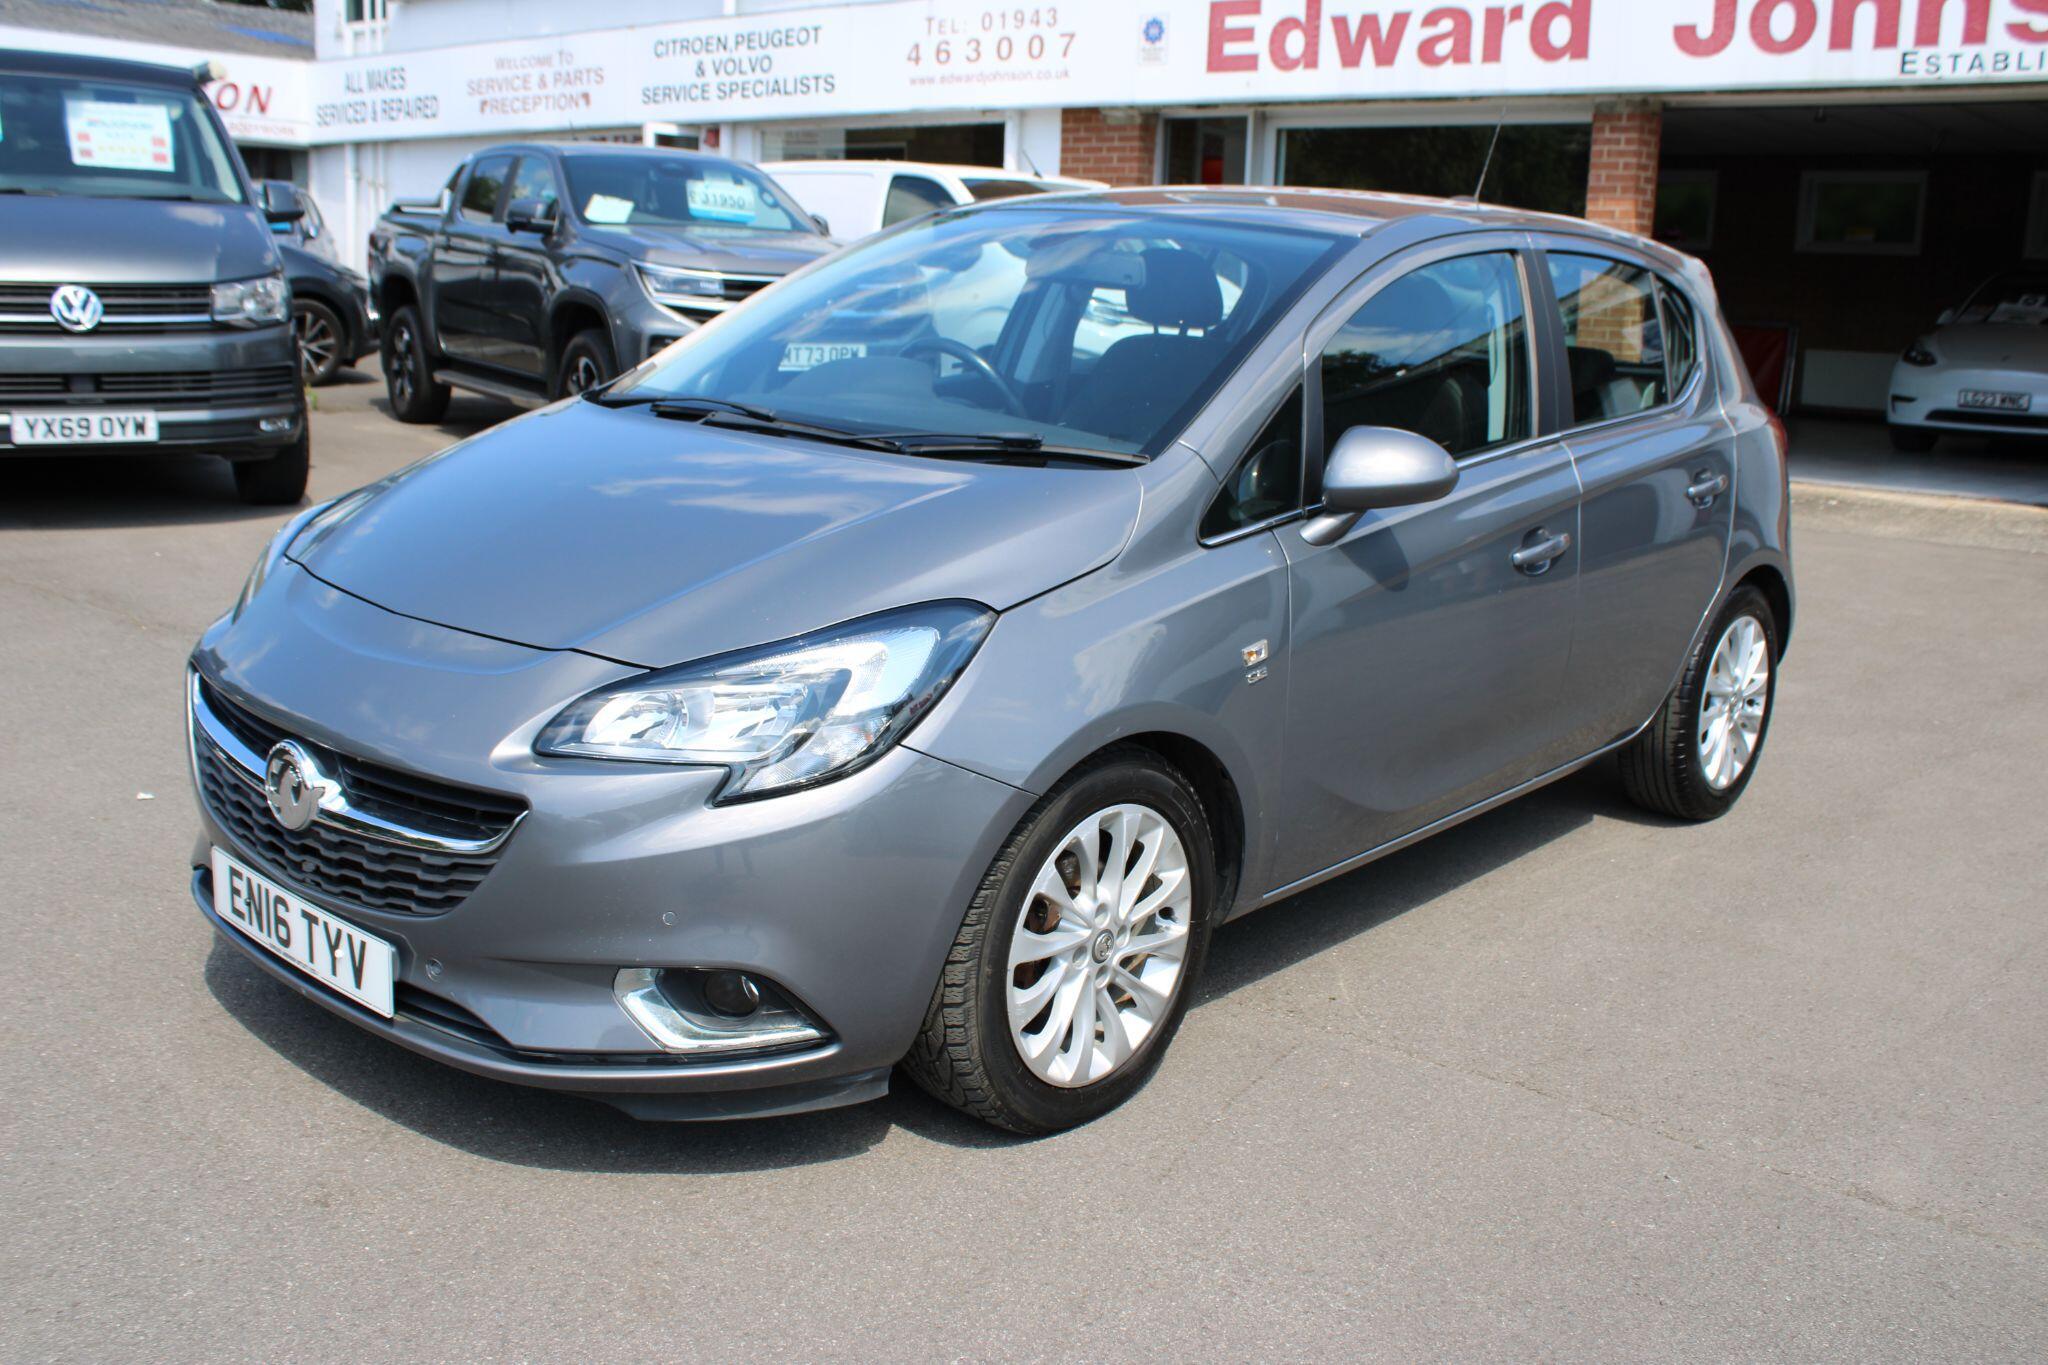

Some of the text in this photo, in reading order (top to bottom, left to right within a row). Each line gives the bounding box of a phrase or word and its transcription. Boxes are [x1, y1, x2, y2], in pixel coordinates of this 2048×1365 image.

[980, 7, 1058, 32] 01943
[906, 32, 1076, 66] 463007
[1206, 0, 1592, 73] Edward
[345, 66, 406, 94] ALL MAKES
[695, 55, 773, 78] & VOLVO
[466, 73, 532, 96] SERVICE
[553, 68, 605, 89] PARTS
[641, 74, 836, 105] SERVICE SPECIALISTS
[317, 100, 367, 127] SERVICED
[382, 95, 439, 121] REPAIRED
[25, 416, 147, 438] YX69 OYW
[229, 864, 367, 991] EN16 TYV
